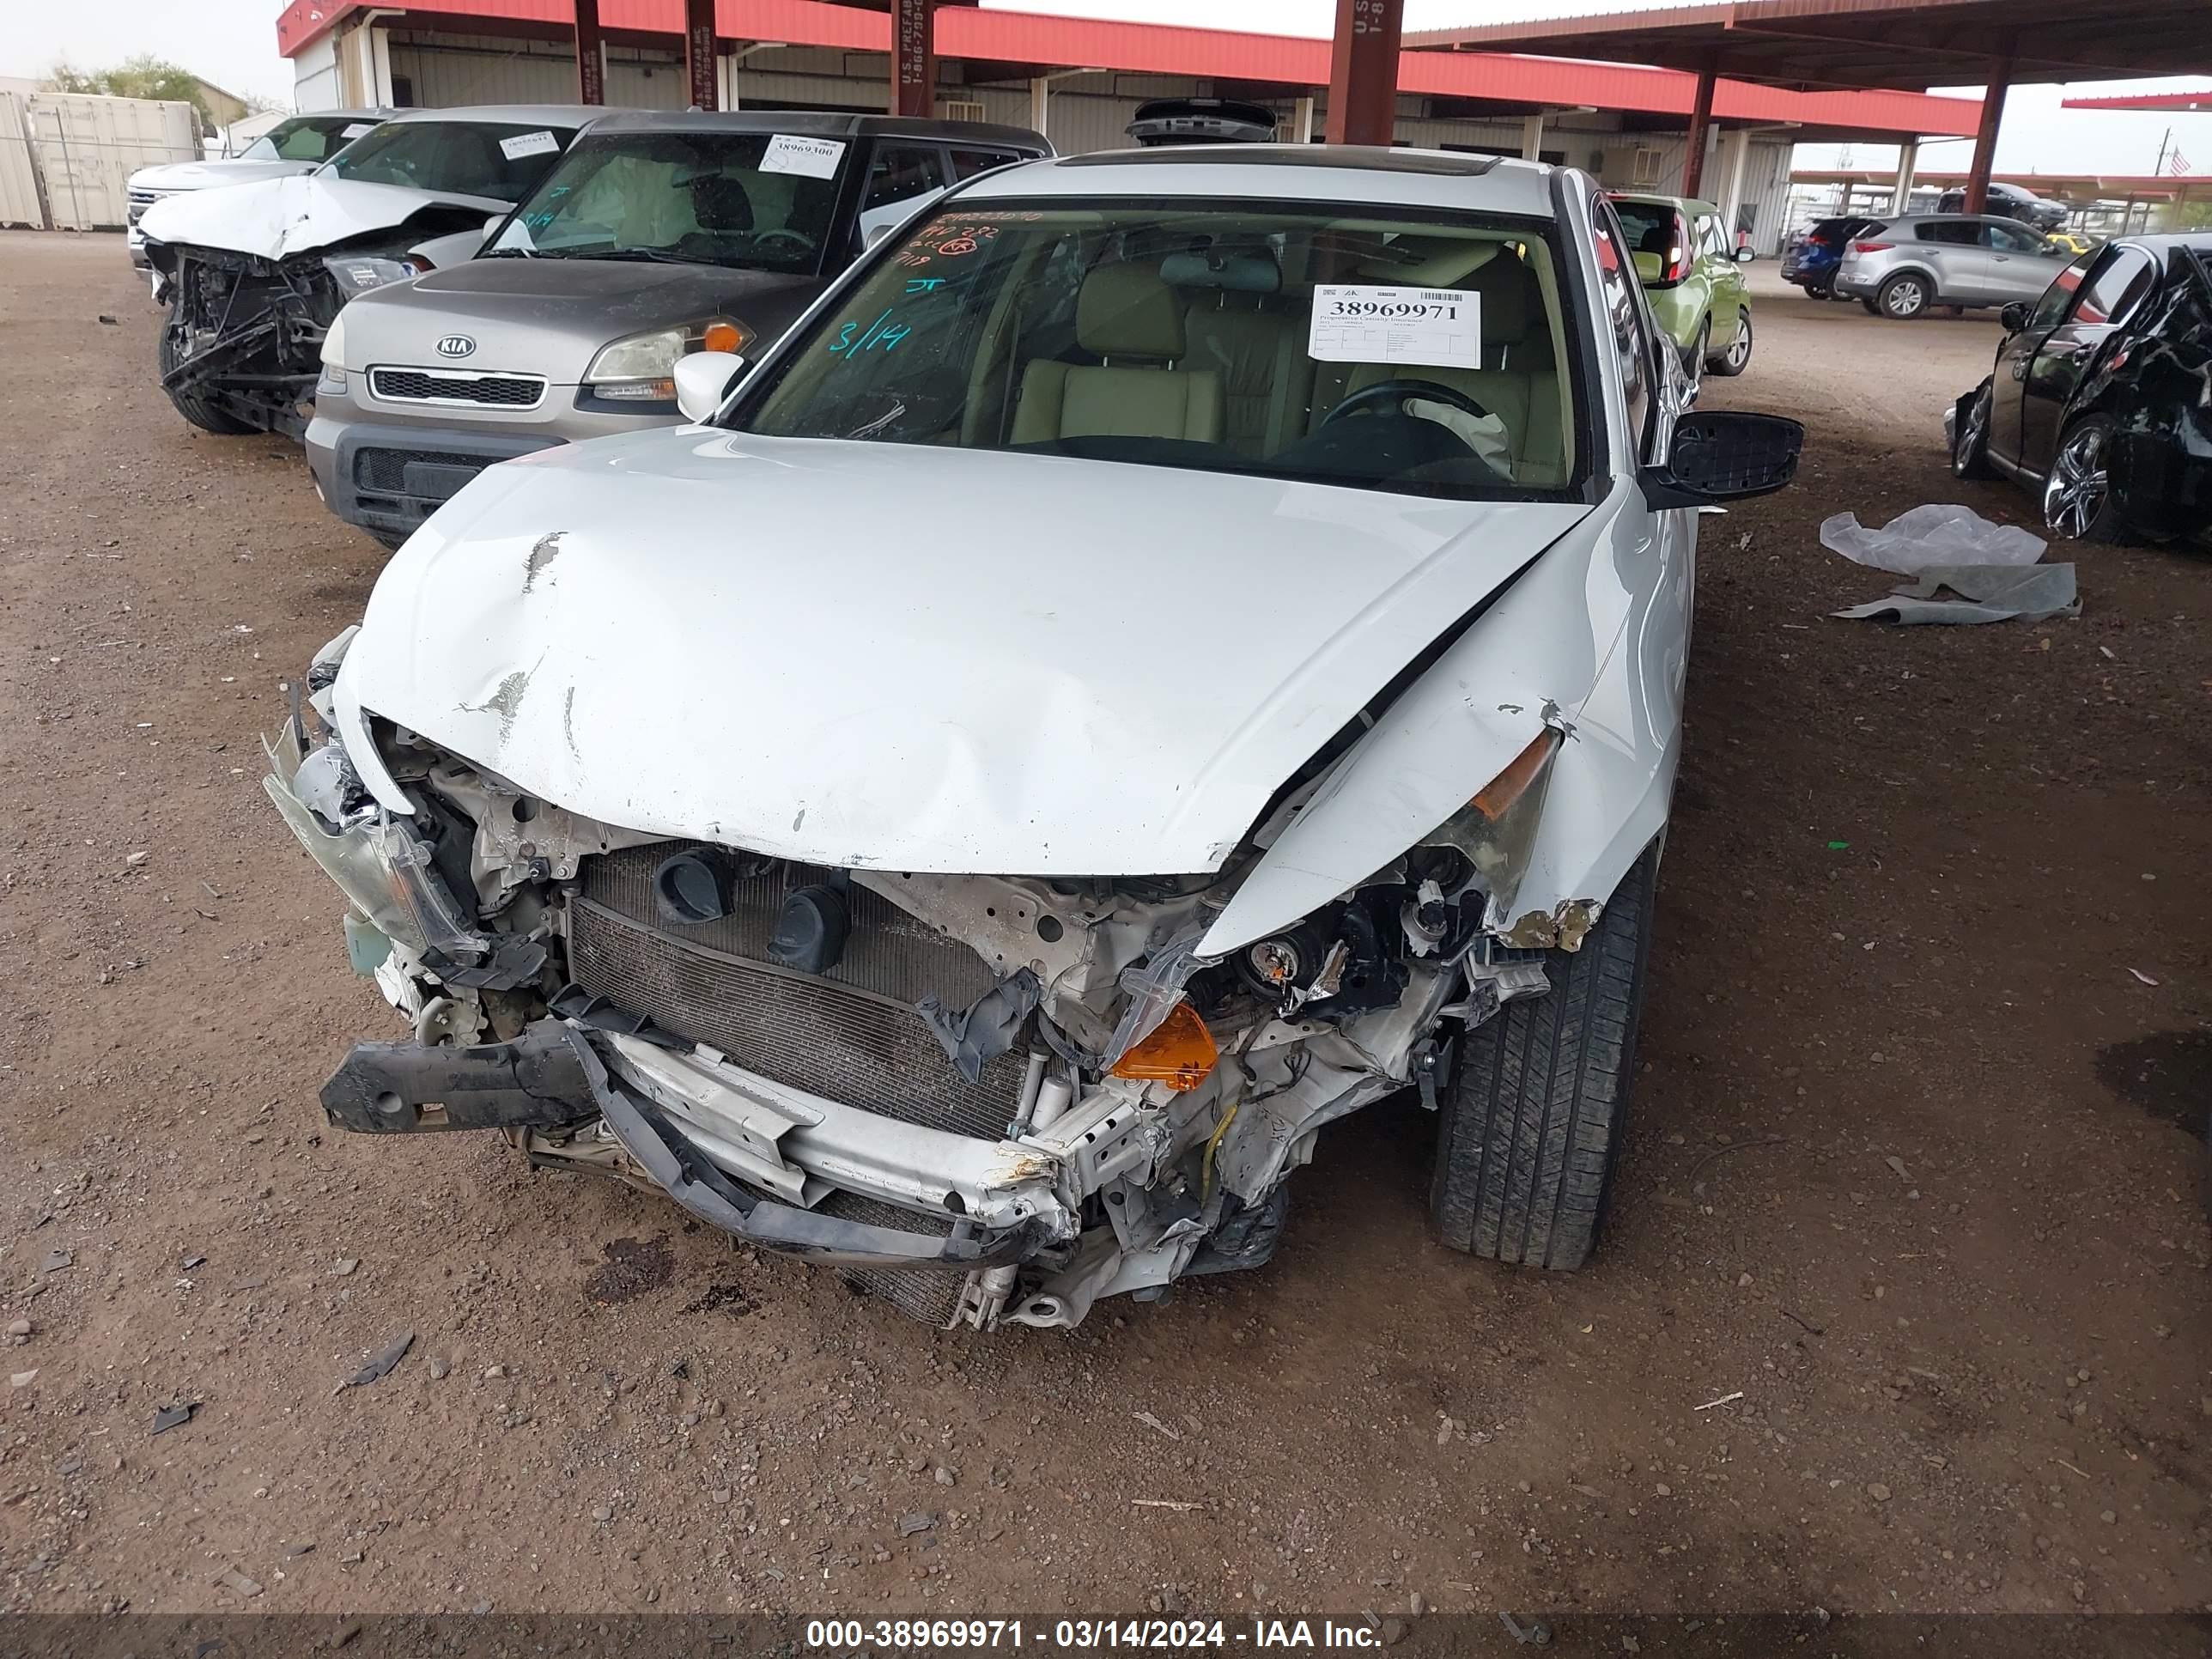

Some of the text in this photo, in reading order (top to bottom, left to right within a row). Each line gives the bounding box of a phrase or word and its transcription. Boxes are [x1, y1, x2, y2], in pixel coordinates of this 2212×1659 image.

[776, 143, 833, 156] 38969300
[1330, 301, 1457, 320] 38969971
[830, 308, 911, 359] 3/14
[441, 339, 467, 353] KIA
